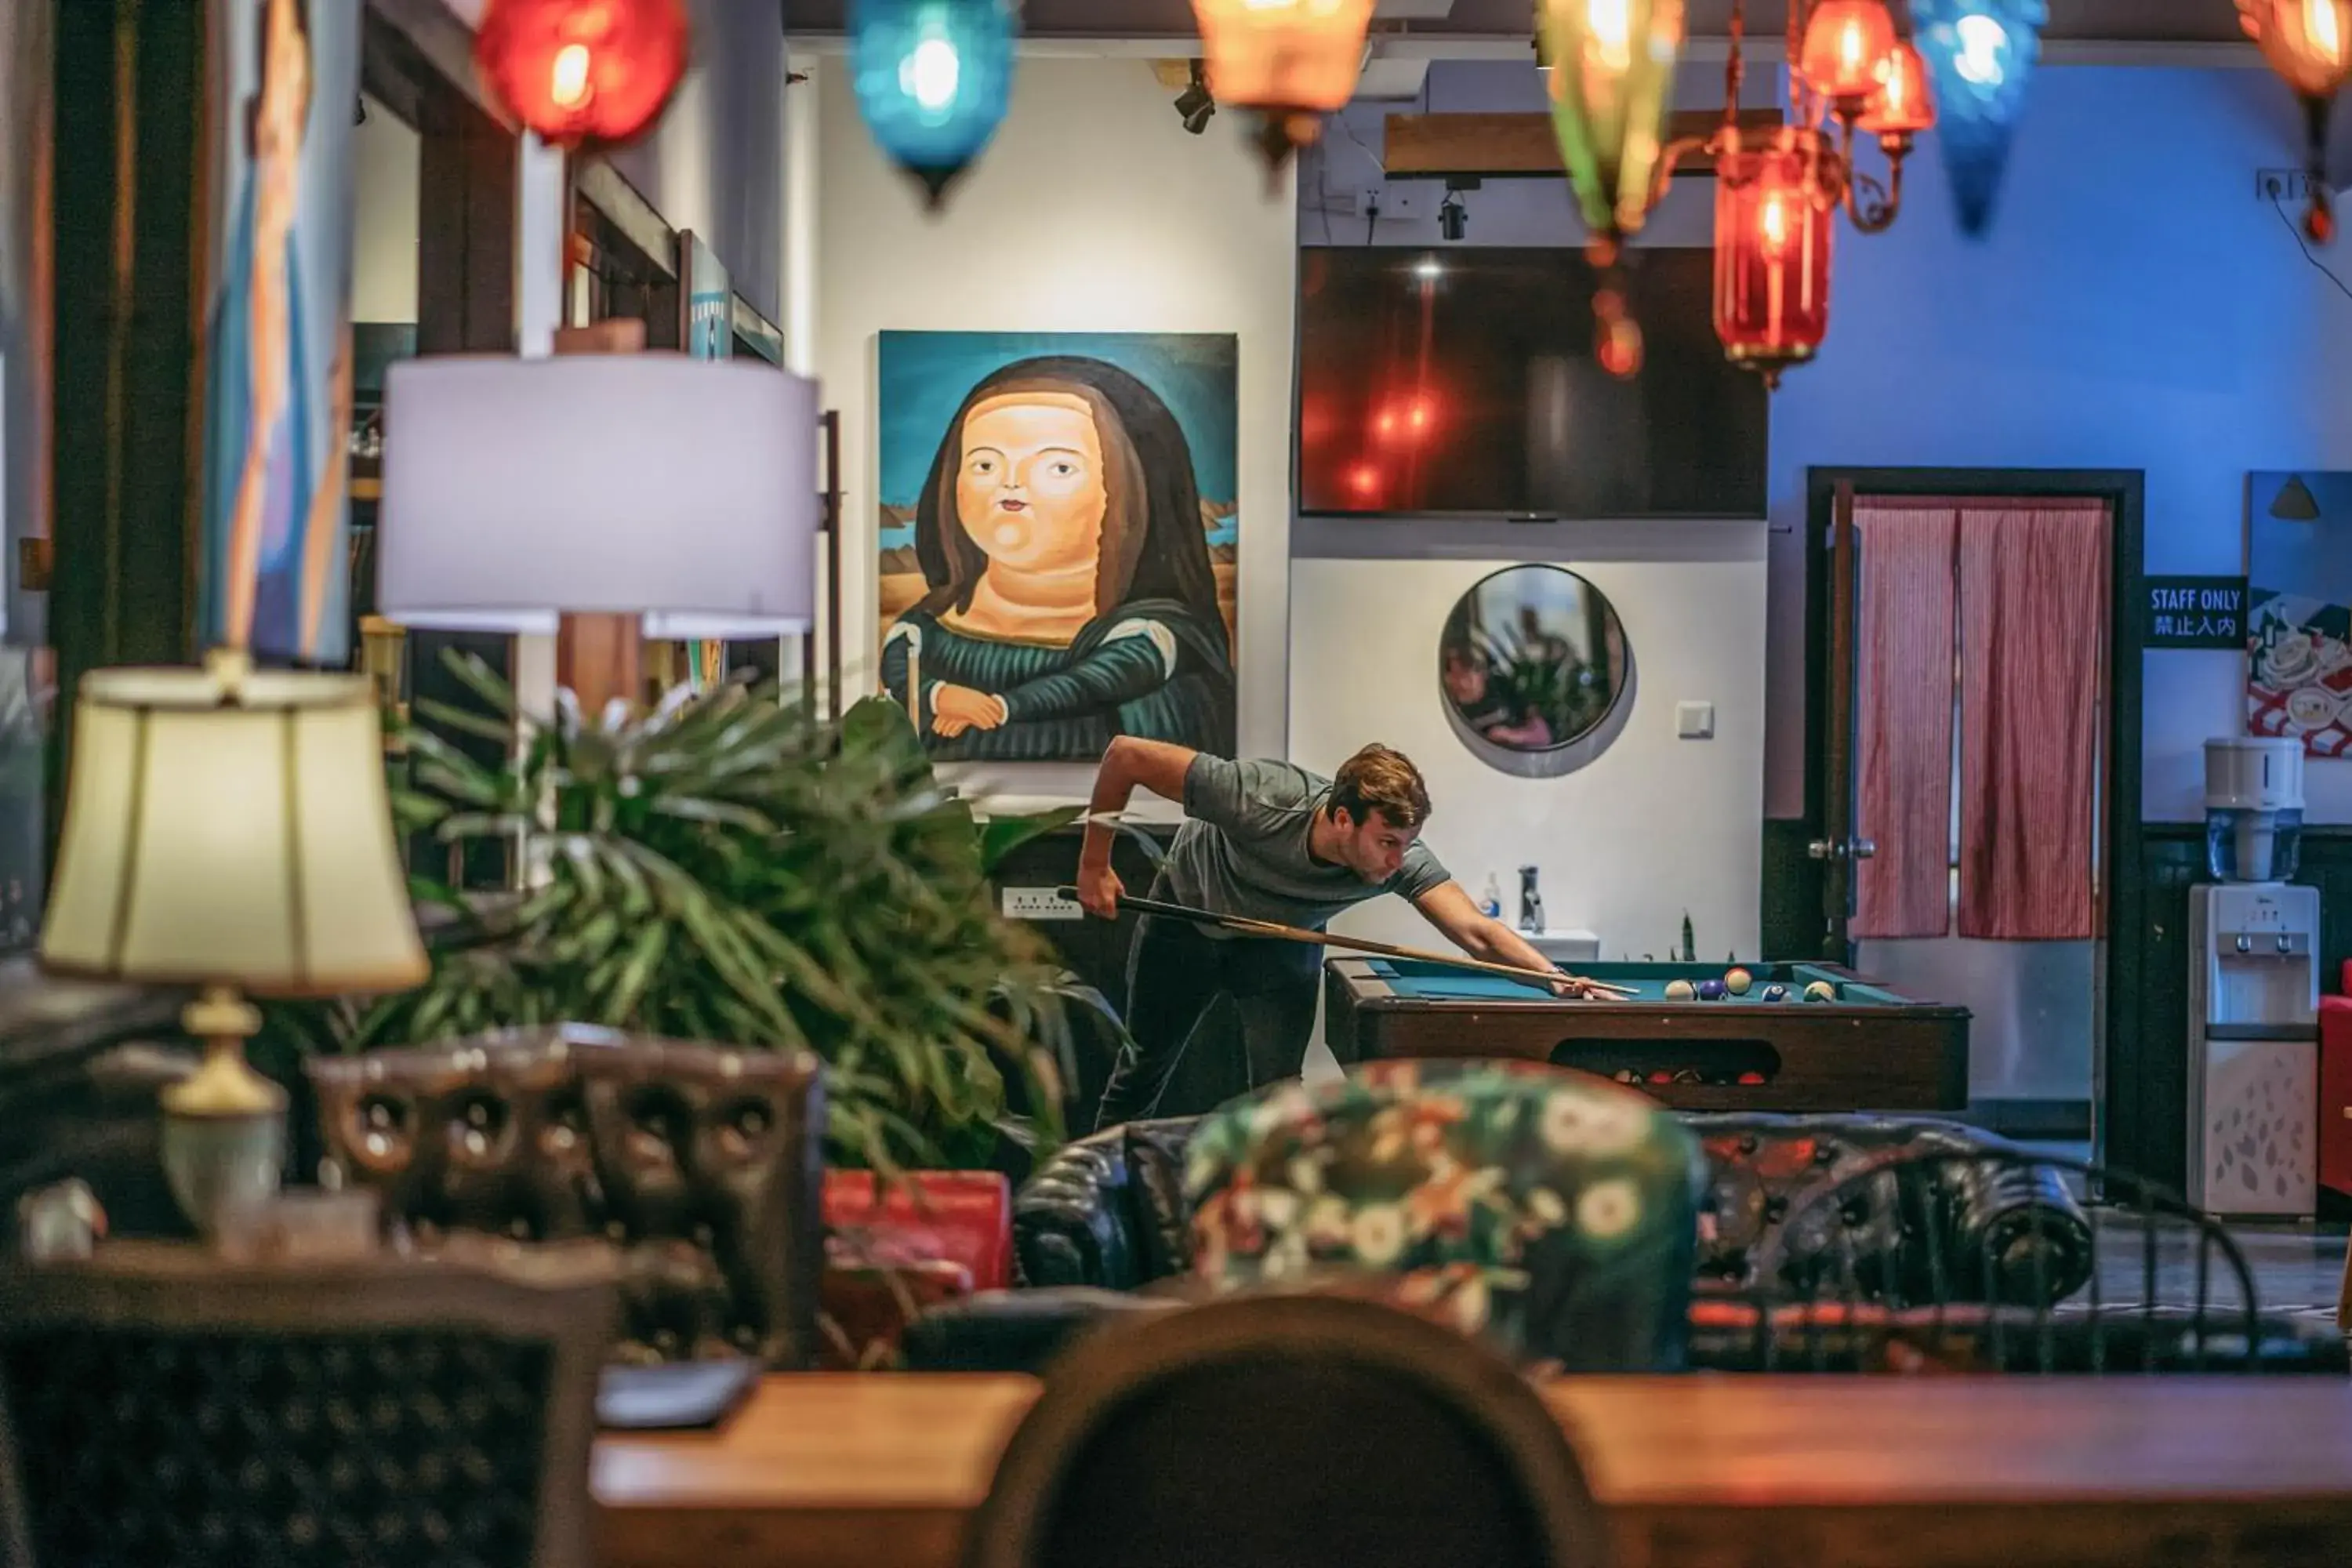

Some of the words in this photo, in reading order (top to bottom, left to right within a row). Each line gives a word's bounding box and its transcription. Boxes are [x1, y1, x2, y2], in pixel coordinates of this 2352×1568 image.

[2151, 589, 2196, 611] STAFF
[2201, 589, 2241, 611] ONLY
[2154, 615, 2236, 637] 禁止入内
